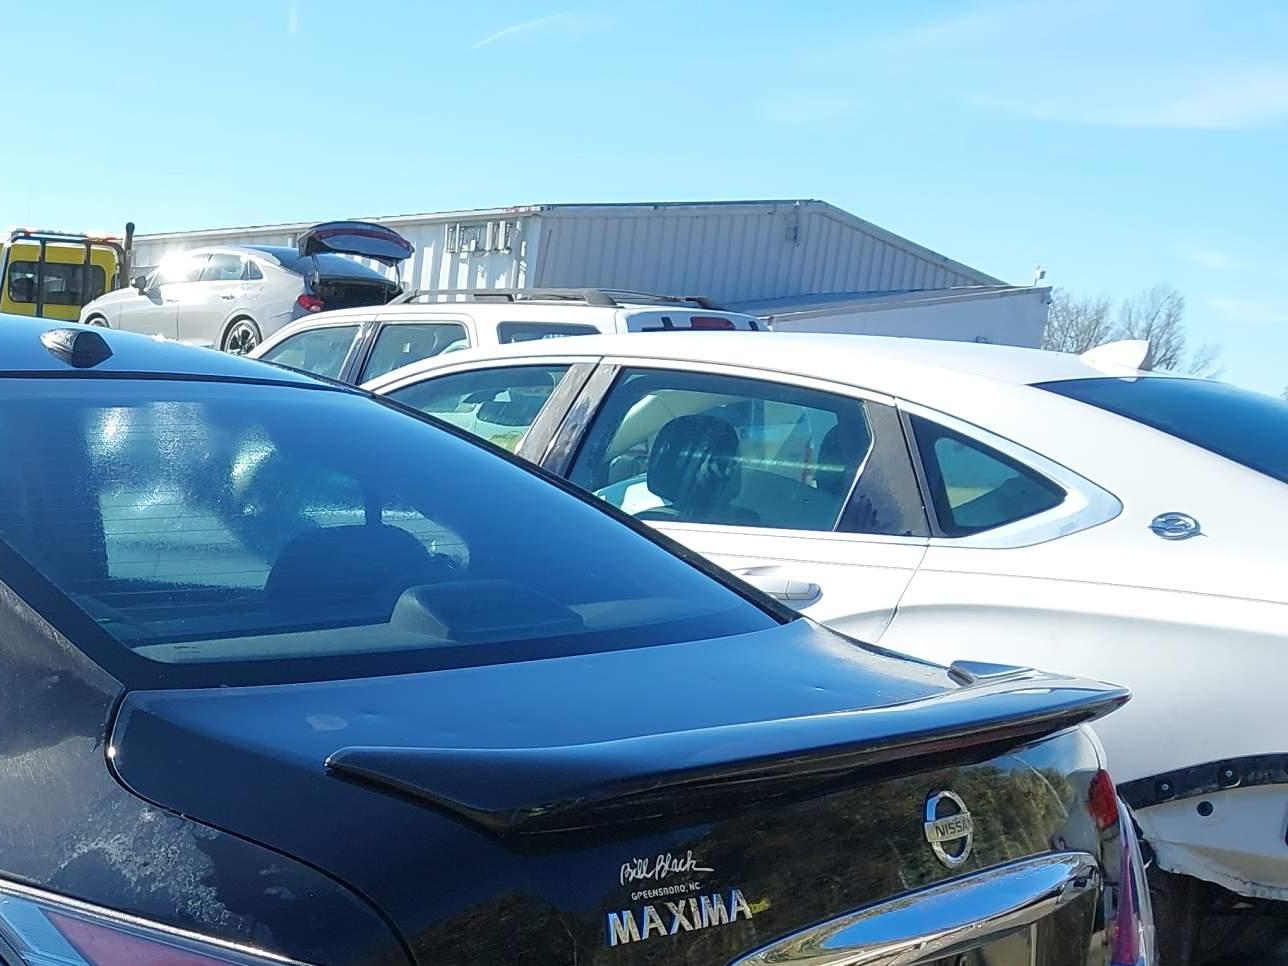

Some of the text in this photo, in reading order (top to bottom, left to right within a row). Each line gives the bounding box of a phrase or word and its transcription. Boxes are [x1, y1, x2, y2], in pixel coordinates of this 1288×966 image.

[935, 817, 971, 837] NISSA
[620, 849, 716, 886] Bill Black
[689, 881, 701, 891] NC
[607, 888, 753, 948] MAXIMA
